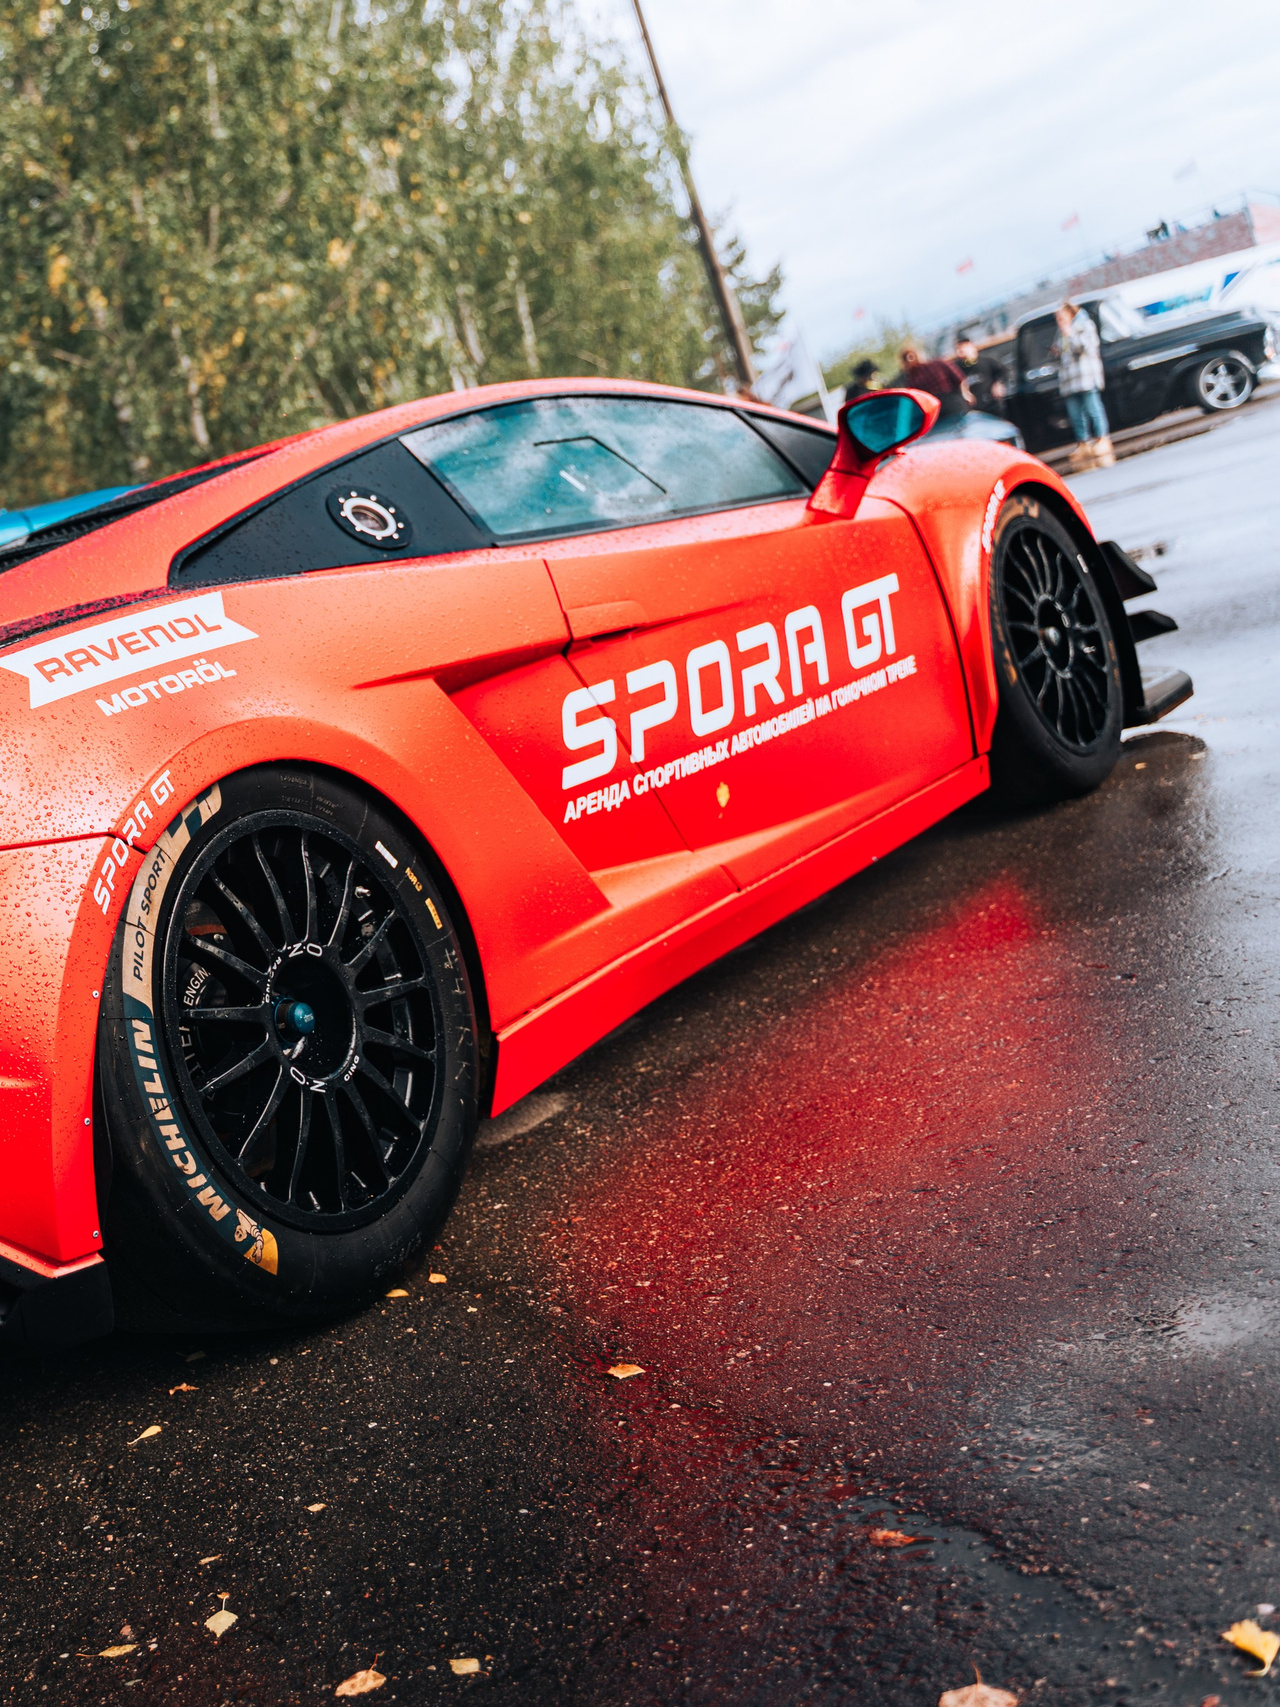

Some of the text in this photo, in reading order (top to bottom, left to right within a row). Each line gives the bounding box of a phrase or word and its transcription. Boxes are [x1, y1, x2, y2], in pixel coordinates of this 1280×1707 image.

[33, 614, 222, 683] RAVENOL
[95, 659, 237, 717] MOTORÖL
[562, 572, 900, 790] SPORA GT
[563, 654, 918, 824] АРЕНДА СПОРТИВНЫХ АВТОМОБИЛЕЙ НА ГОНОЧНОМ ТРЕКЕ
[93, 769, 175, 915] SPORA GT
[133, 848, 167, 982] PILOT SPORT
[183, 966, 211, 1007] ENGIN
[131, 1018, 232, 1222] MICHELIN
